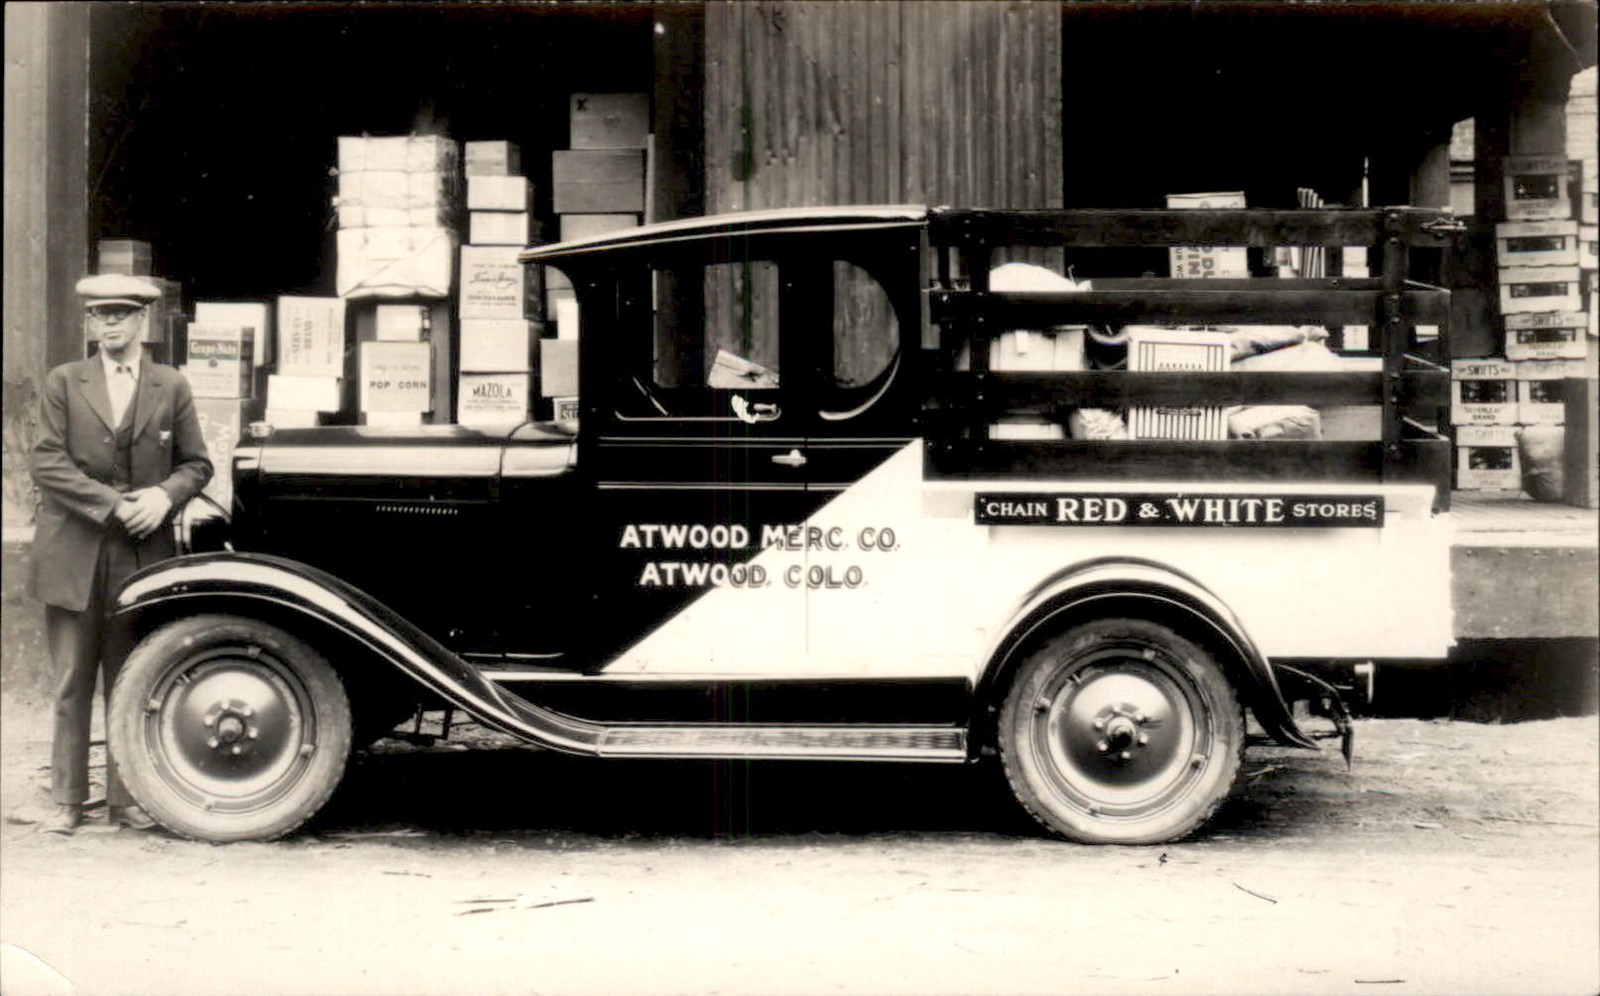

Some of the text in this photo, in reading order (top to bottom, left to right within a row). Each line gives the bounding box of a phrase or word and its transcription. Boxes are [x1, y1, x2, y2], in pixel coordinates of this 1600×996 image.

[1467, 364, 1499, 376] SWIFTS
[369, 381, 427, 390] POP CORN
[472, 382, 513, 398] MAZOLA
[986, 498, 1377, 523] CHAIN RED & WHITE STORES
[619, 524, 749, 549] ATWOOD
[857, 527, 901, 552] CO.
[784, 564, 868, 589] COLO.
